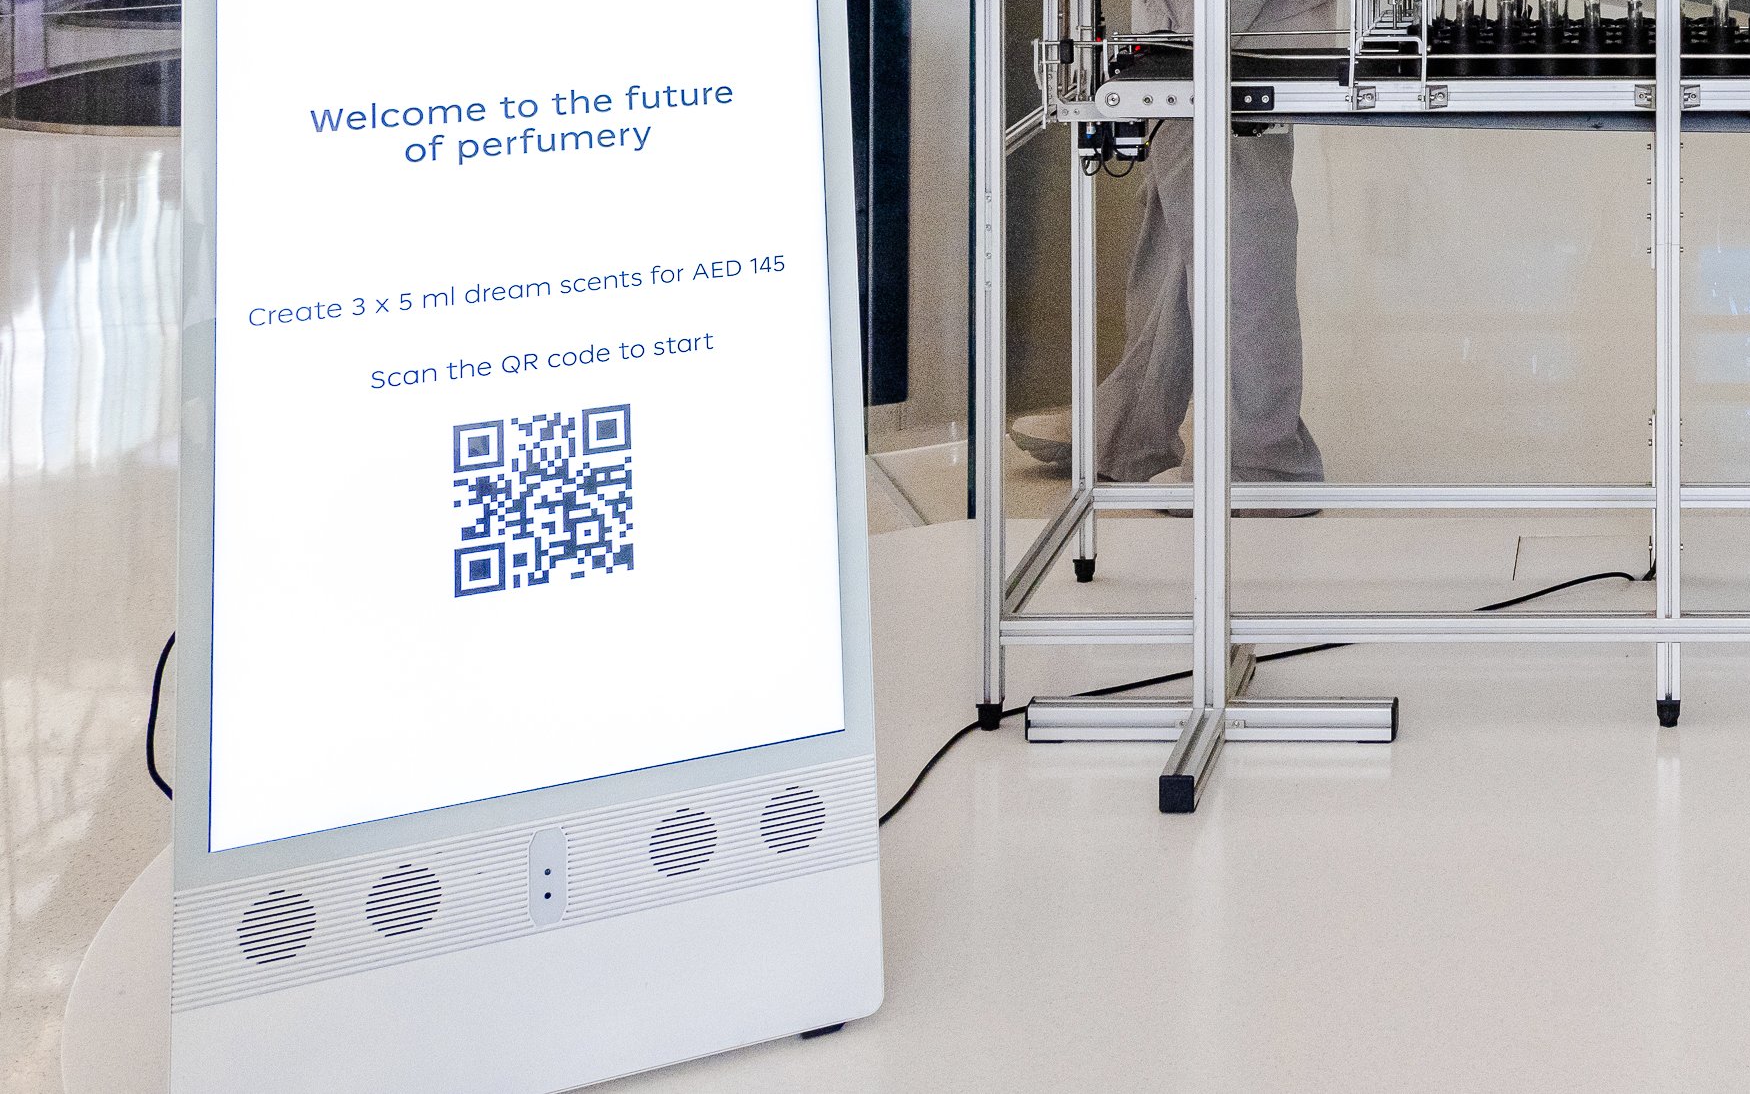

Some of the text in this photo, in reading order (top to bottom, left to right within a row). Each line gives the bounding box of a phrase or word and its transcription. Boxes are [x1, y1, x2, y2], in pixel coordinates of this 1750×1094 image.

[309, 84, 733, 133] Welcome to the future
[405, 126, 652, 166] of perfumery
[248, 254, 786, 327] Create 3 x 5 ml dream scents for AED 145
[370, 332, 714, 389] Scan the QR code to start
